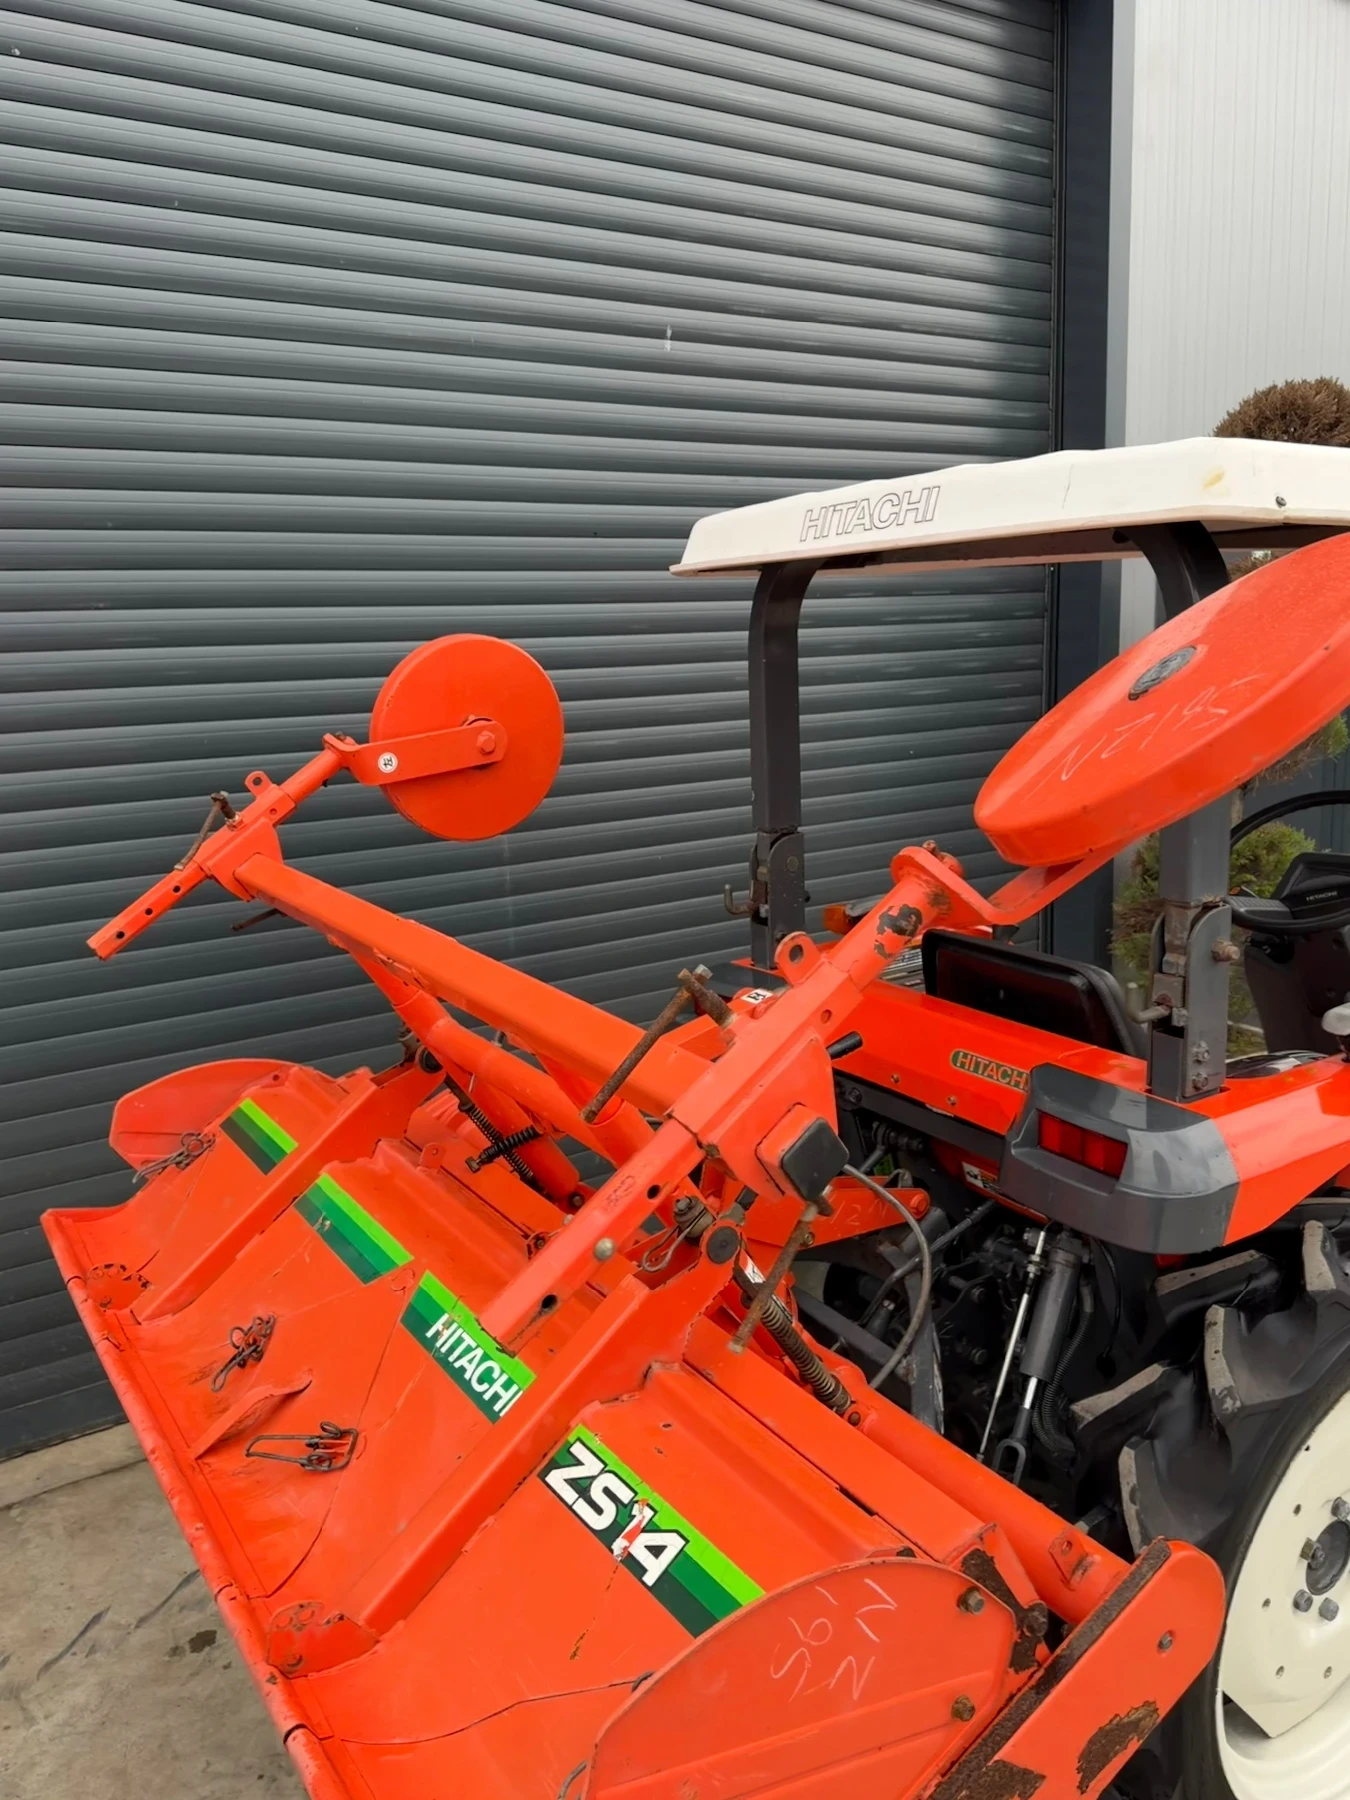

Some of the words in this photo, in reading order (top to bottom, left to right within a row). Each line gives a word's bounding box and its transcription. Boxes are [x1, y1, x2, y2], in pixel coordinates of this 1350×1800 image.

[799, 485, 941, 542] HITACHI
[956, 1051, 1029, 1091] HITACH
[544, 1439, 688, 1588] ZS14
